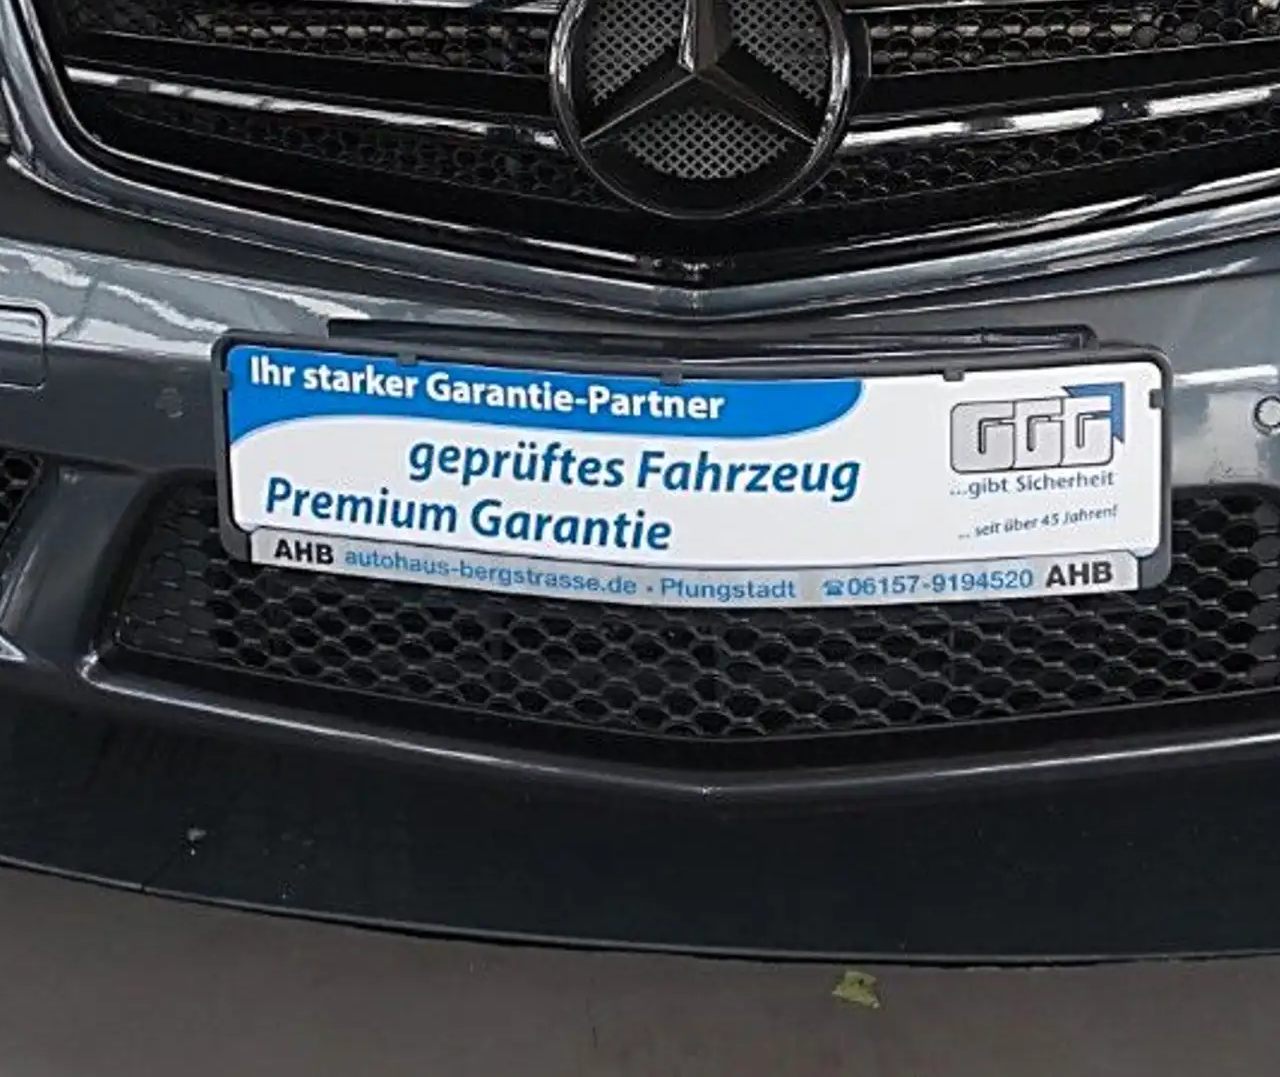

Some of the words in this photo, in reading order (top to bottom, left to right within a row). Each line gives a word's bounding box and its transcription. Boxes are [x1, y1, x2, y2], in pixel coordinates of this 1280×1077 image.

[250, 355, 295, 387] Ihr
[303, 363, 418, 399] starker
[425, 372, 725, 419] Garantie-Partner
[950, 396, 1114, 474] GGG
[409, 441, 625, 486] geprüftes
[637, 450, 861, 502] Fahrzeug
[1016, 471, 1114, 492] Sicherheit
[266, 477, 457, 533] Premium
[470, 498, 672, 550] Garantie
[975, 522, 1001, 537] seit
[1004, 516, 1038, 533] über
[1041, 513, 1059, 527] 45
[1063, 504, 1118, 525] Jahren!
[275, 538, 334, 565] AHB
[344, 549, 637, 594] autohaus-bergstrasse.de
[661, 577, 796, 602] Pfungstadt
[848, 568, 1034, 596] 06157-9194520
[1045, 561, 1113, 589] AHB
